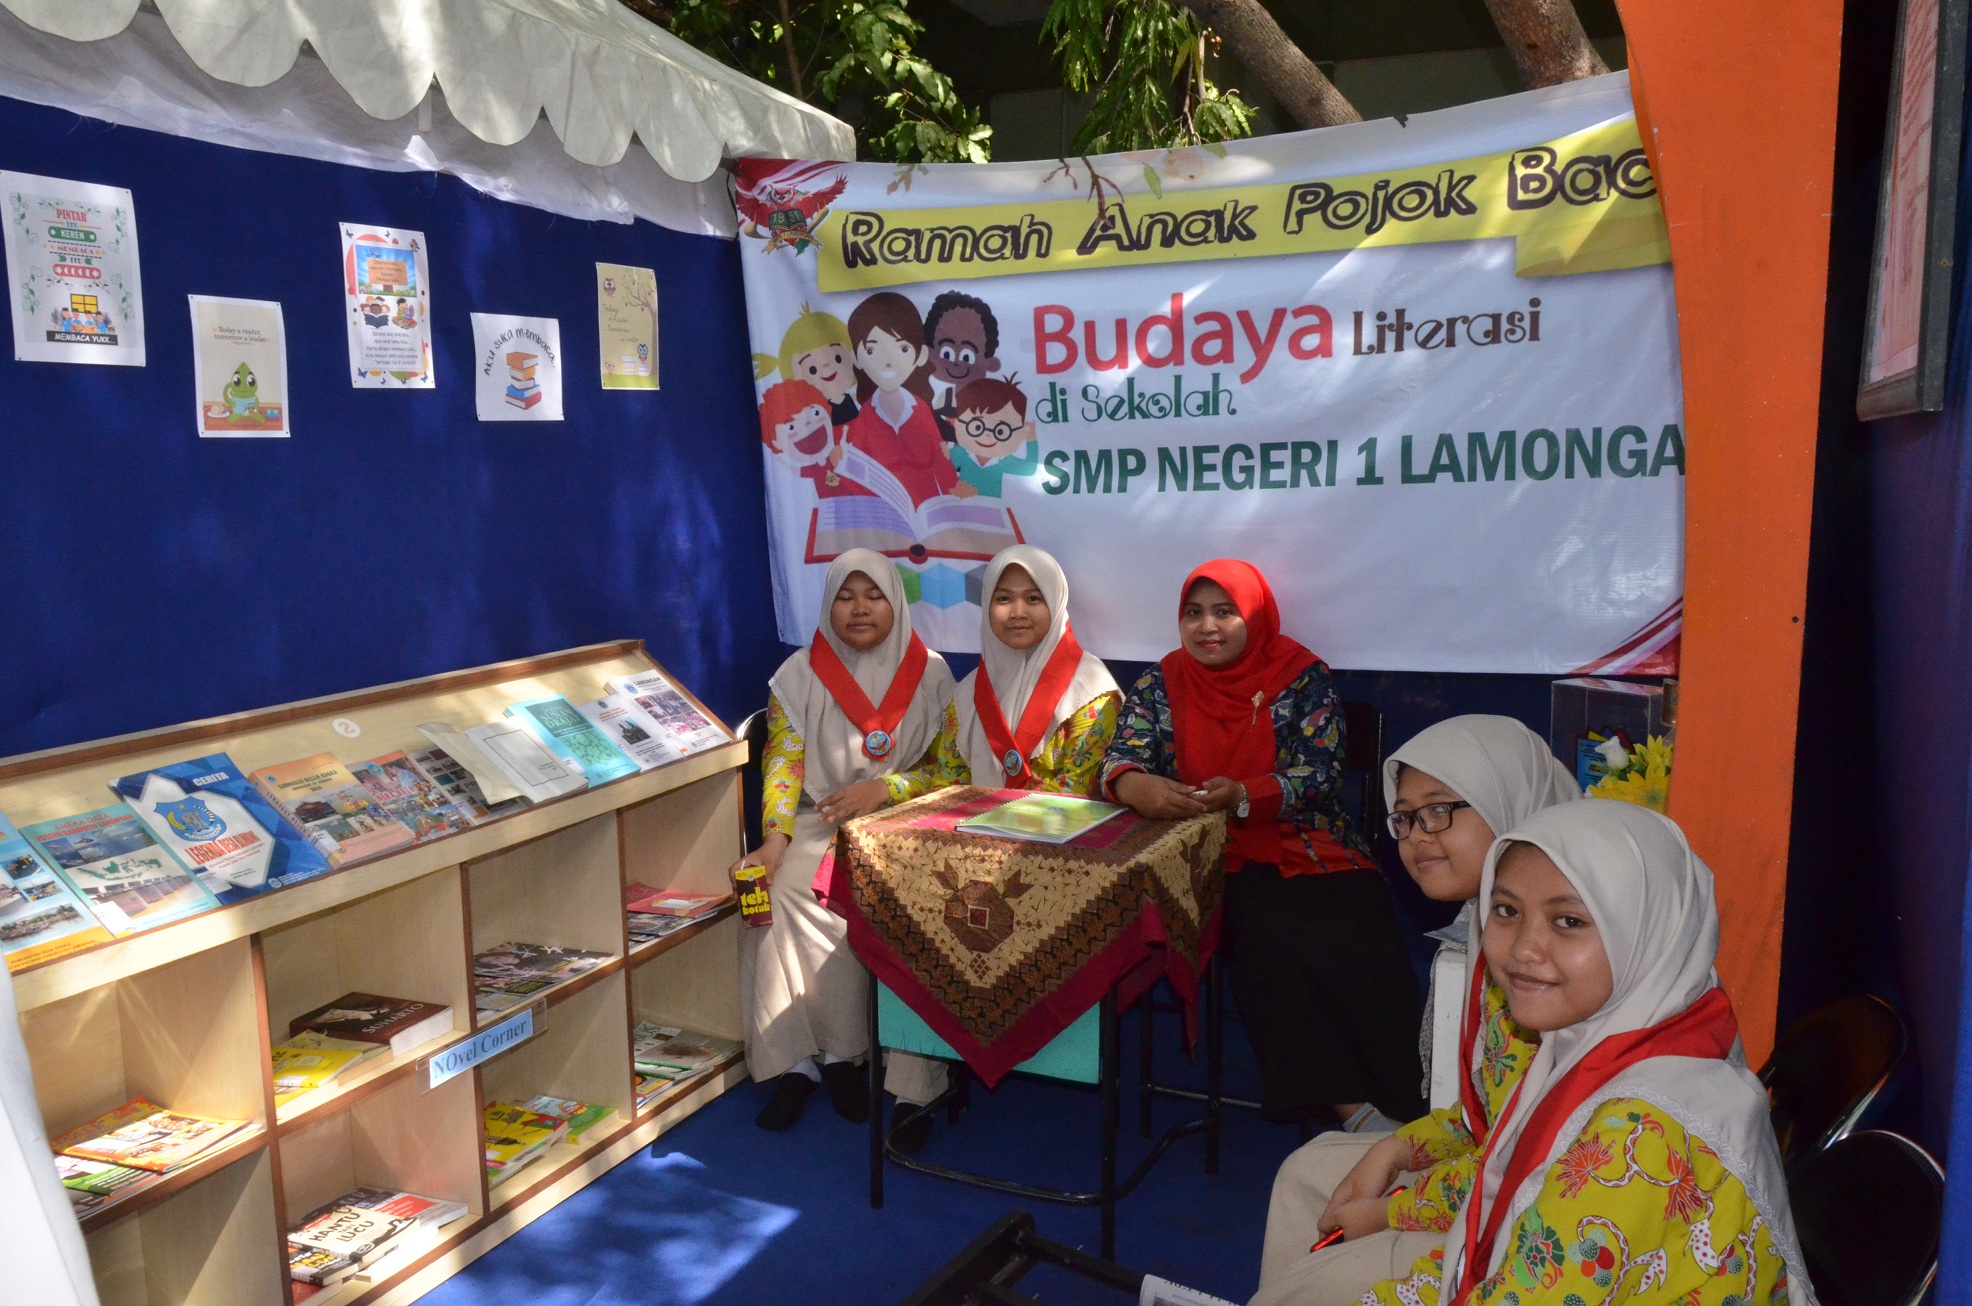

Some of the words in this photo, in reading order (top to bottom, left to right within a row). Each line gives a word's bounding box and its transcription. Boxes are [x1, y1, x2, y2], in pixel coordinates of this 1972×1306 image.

[56, 208, 87, 222] PINTAR
[842, 211, 1053, 269] Ramah
[1076, 199, 1259, 256] Anak
[1283, 168, 1478, 236] Pojok
[60, 229, 85, 240] KEREN
[54, 333, 90, 342] MEMBACA
[1033, 292, 1333, 385] Budaya
[1352, 297, 1541, 356] Literasi
[1035, 381, 1069, 424] di
[1081, 373, 1237, 422] Sekolah
[1041, 447, 1146, 495] SMP
[1157, 440, 1338, 493] NEGERI
[1356, 437, 1384, 486] 1
[337, 722, 357, 734] 2
[192, 772, 229, 786] CERITA
[54, 819, 85, 831] ANEKA
[86, 813, 110, 823] DATA
[185, 840, 228, 866] LEGENDA
[217, 836, 242, 854] DESA
[740, 886, 769, 907] teh
[742, 902, 770, 916] kotak
[361, 1003, 424, 1034] SUHARTO
[433, 1041, 477, 1079] NOvel
[481, 1020, 527, 1053] Corner
[308, 1212, 361, 1242] HANTU
[336, 1220, 375, 1243] LUCU
